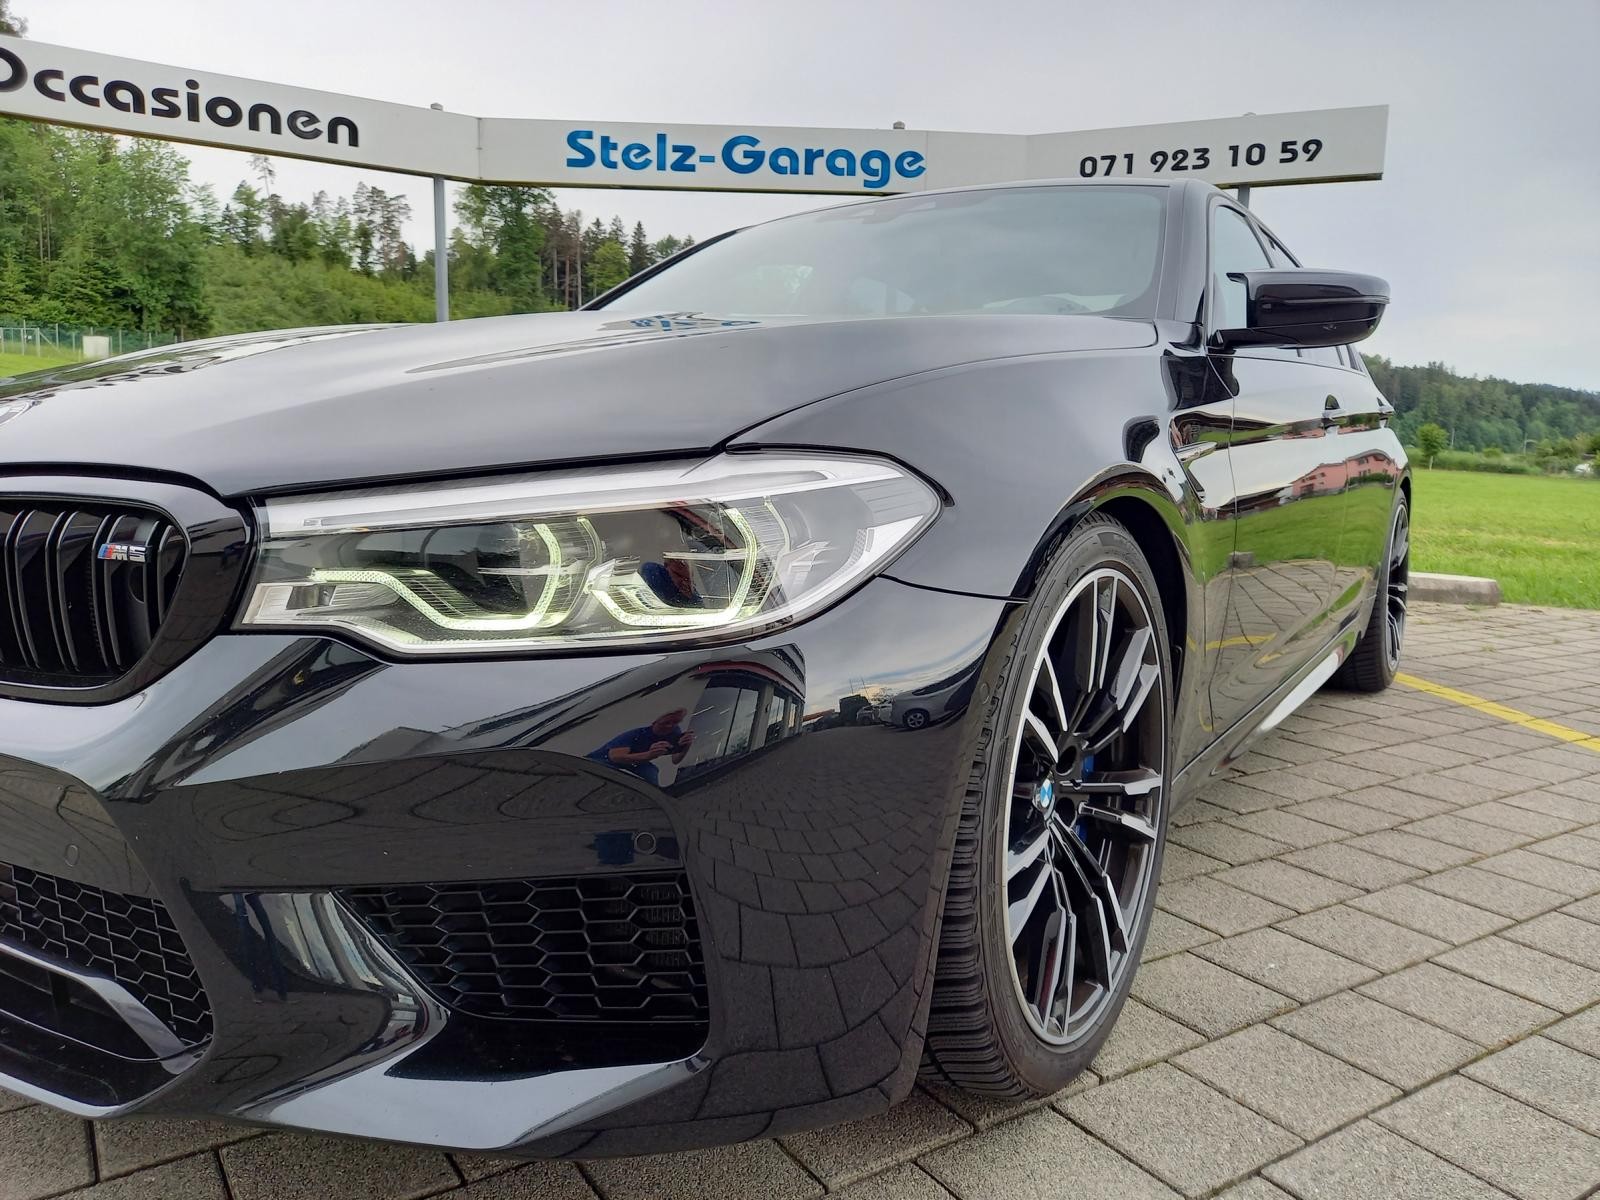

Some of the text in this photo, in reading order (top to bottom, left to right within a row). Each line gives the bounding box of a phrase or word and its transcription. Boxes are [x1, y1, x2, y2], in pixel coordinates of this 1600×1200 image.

[565, 129, 927, 189] Stelz-Garage
[1079, 138, 1323, 178] 071 923 10 59
